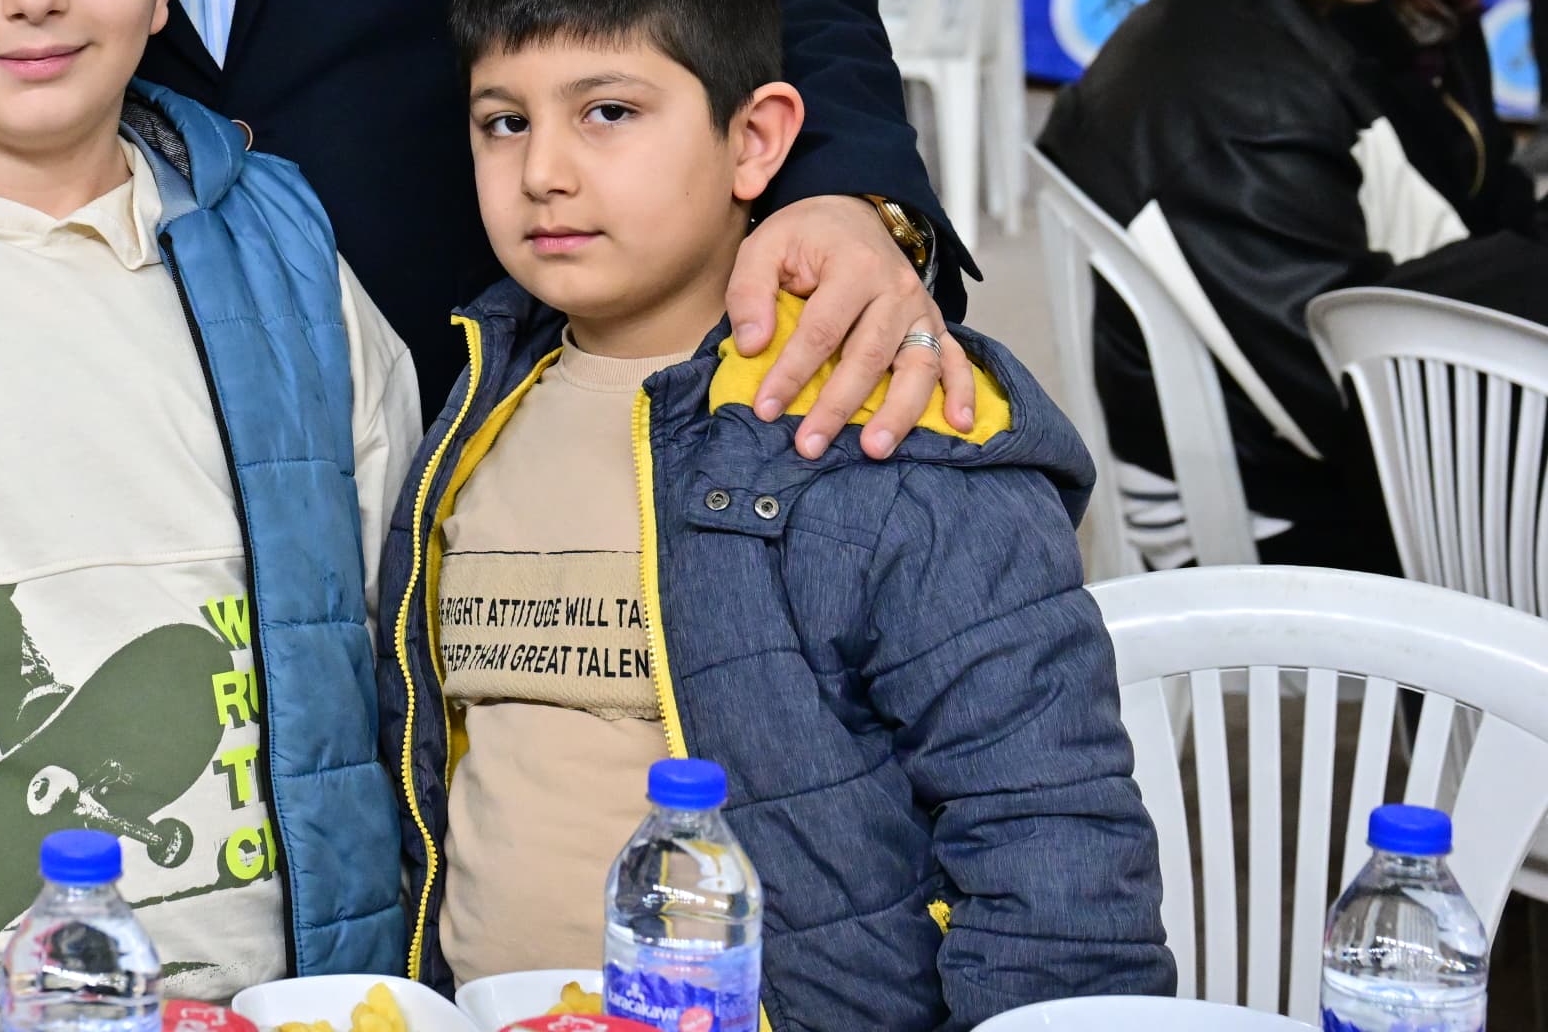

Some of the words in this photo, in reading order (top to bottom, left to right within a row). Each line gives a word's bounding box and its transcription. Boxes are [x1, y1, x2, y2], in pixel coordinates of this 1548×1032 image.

[486, 598, 562, 628] ATTITUDE
[565, 597, 609, 628] WILL
[615, 599, 648, 629] TA
[469, 644, 511, 670] THAN
[510, 644, 573, 676] GREAT
[576, 646, 653, 678] TALEN
